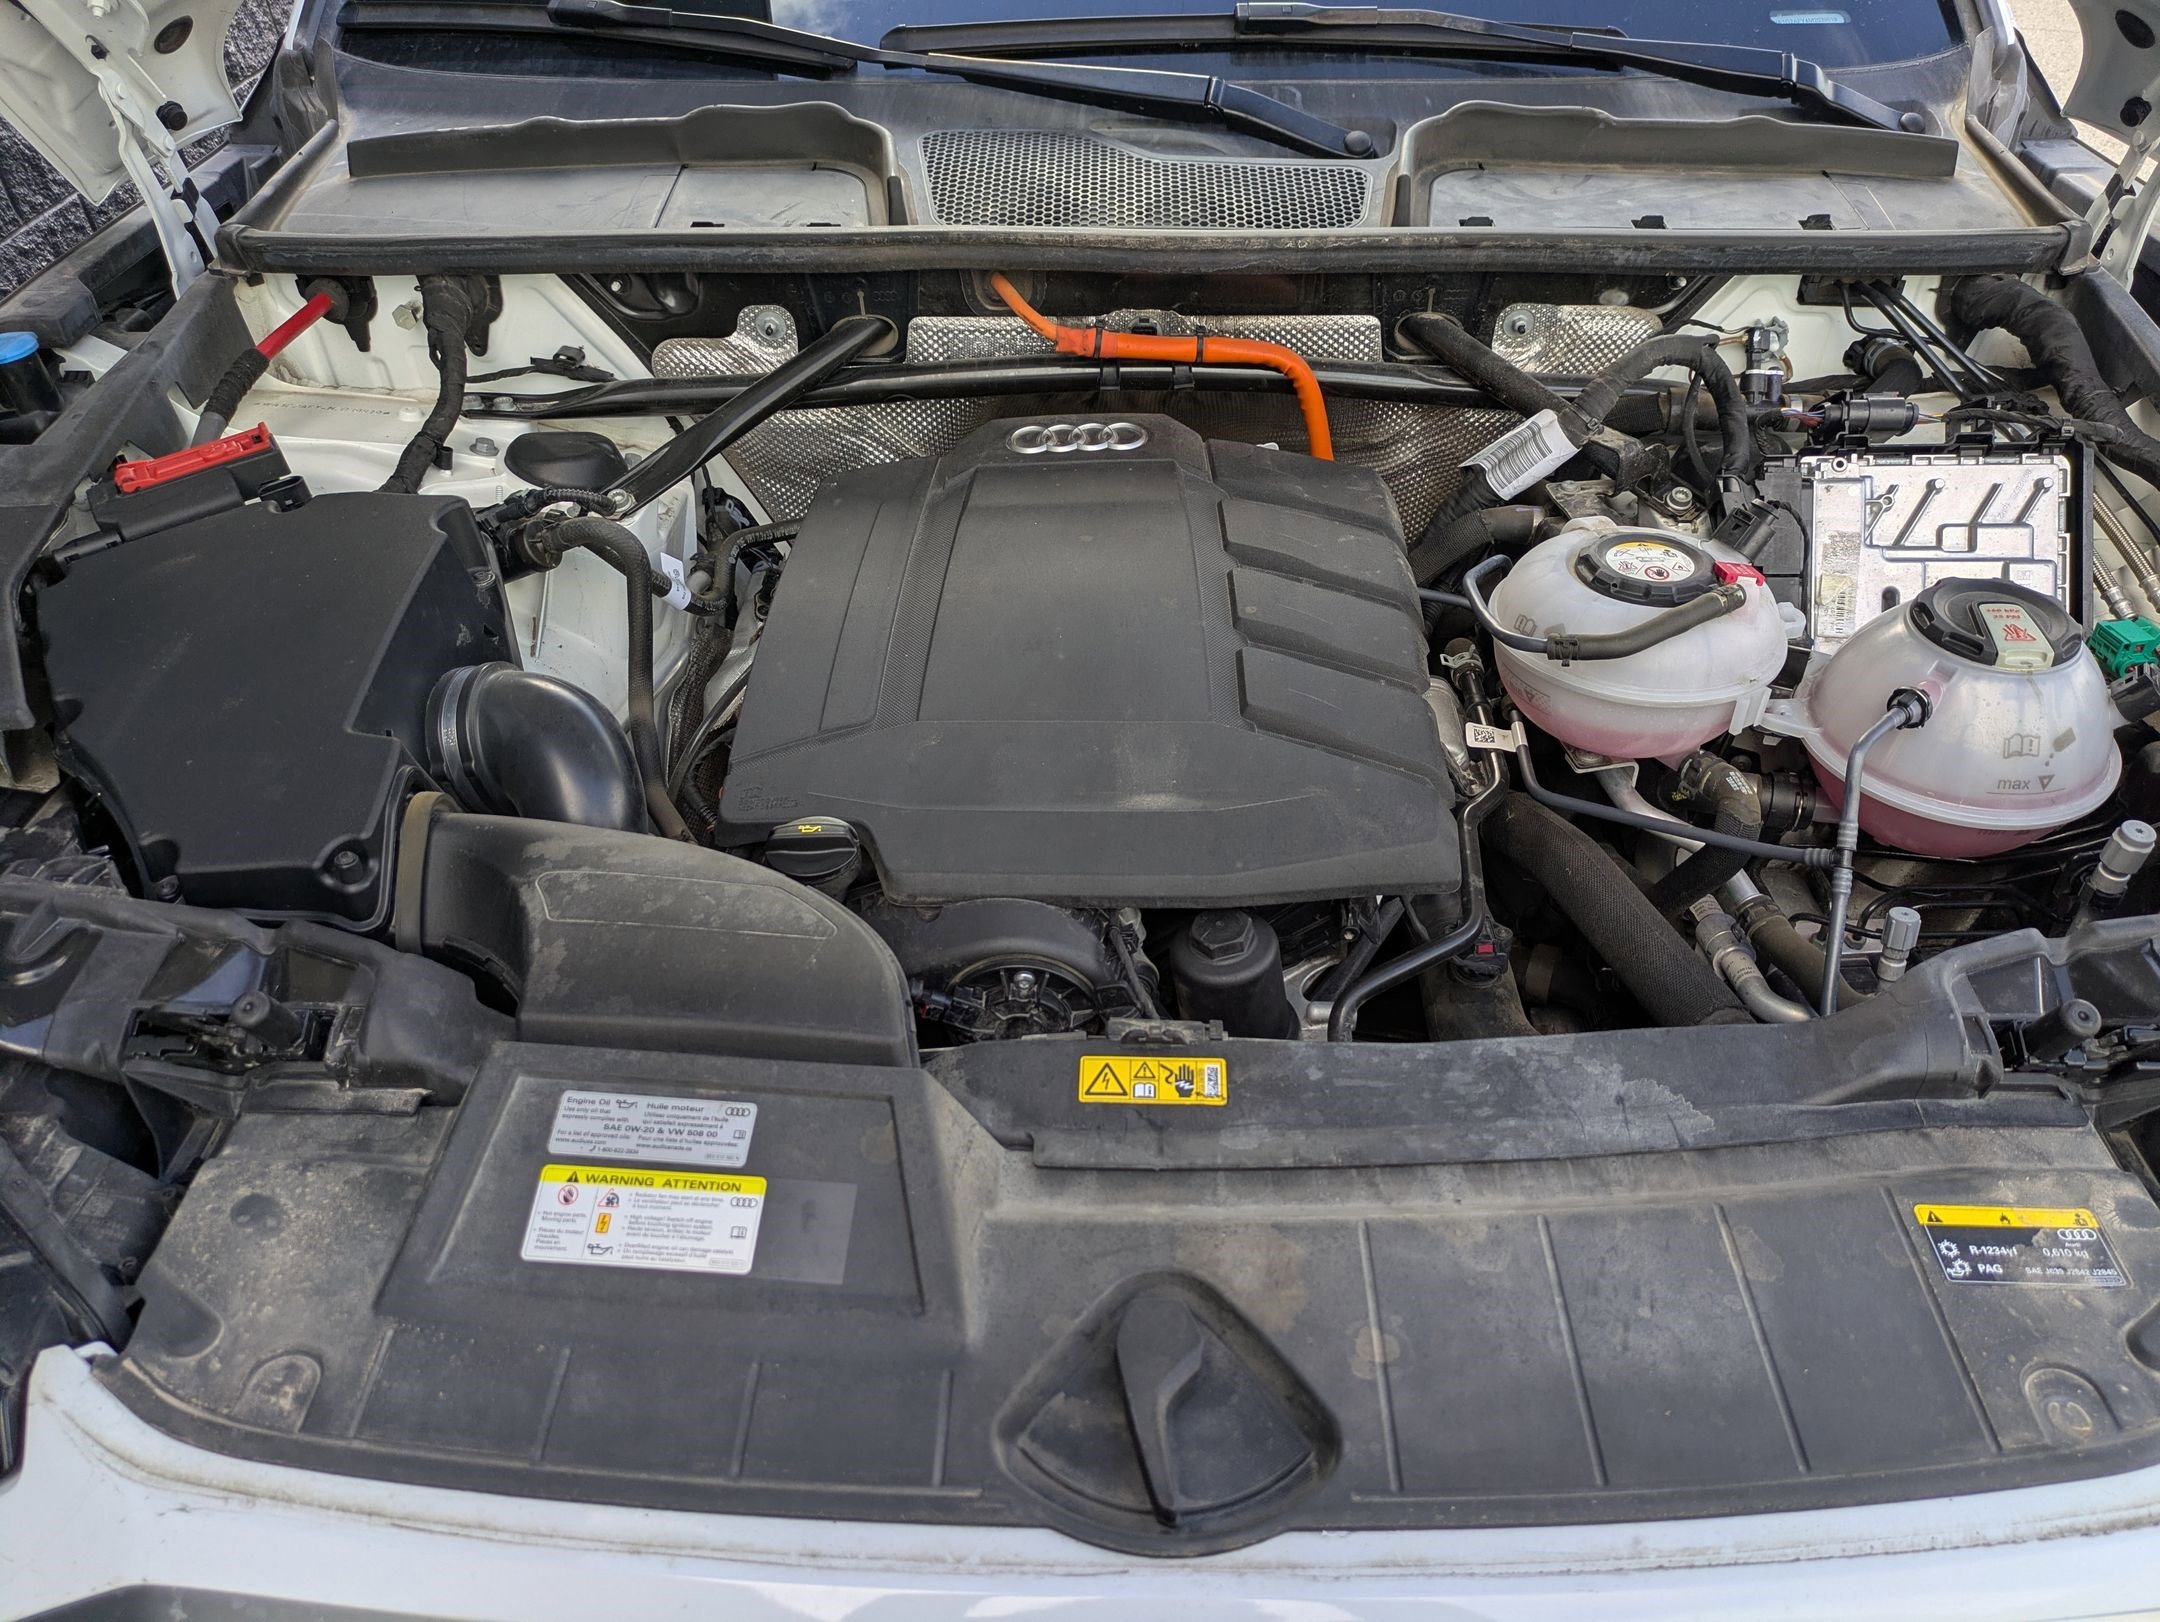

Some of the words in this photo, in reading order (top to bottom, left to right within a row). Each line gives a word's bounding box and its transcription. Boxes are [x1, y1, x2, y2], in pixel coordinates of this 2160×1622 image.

[1997, 778, 2031, 790] max
[567, 1096, 596, 1106] Engine
[598, 1098, 611, 1106] Oil
[647, 1102, 669, 1111] Huile
[603, 1123, 622, 1131] SAE
[625, 1125, 655, 1134] 0W-20
[668, 1128, 685, 1136] VW
[585, 1173, 655, 1187] WARNING
[661, 1178, 742, 1192] ATTENTION
[1969, 1245, 2018, 1257] R-1234yf
[2042, 1248, 2073, 1258] 0,610
[2075, 1248, 2090, 1259] kg
[1977, 1264, 2003, 1274] PAG
[2025, 1267, 2043, 1275] SAE
